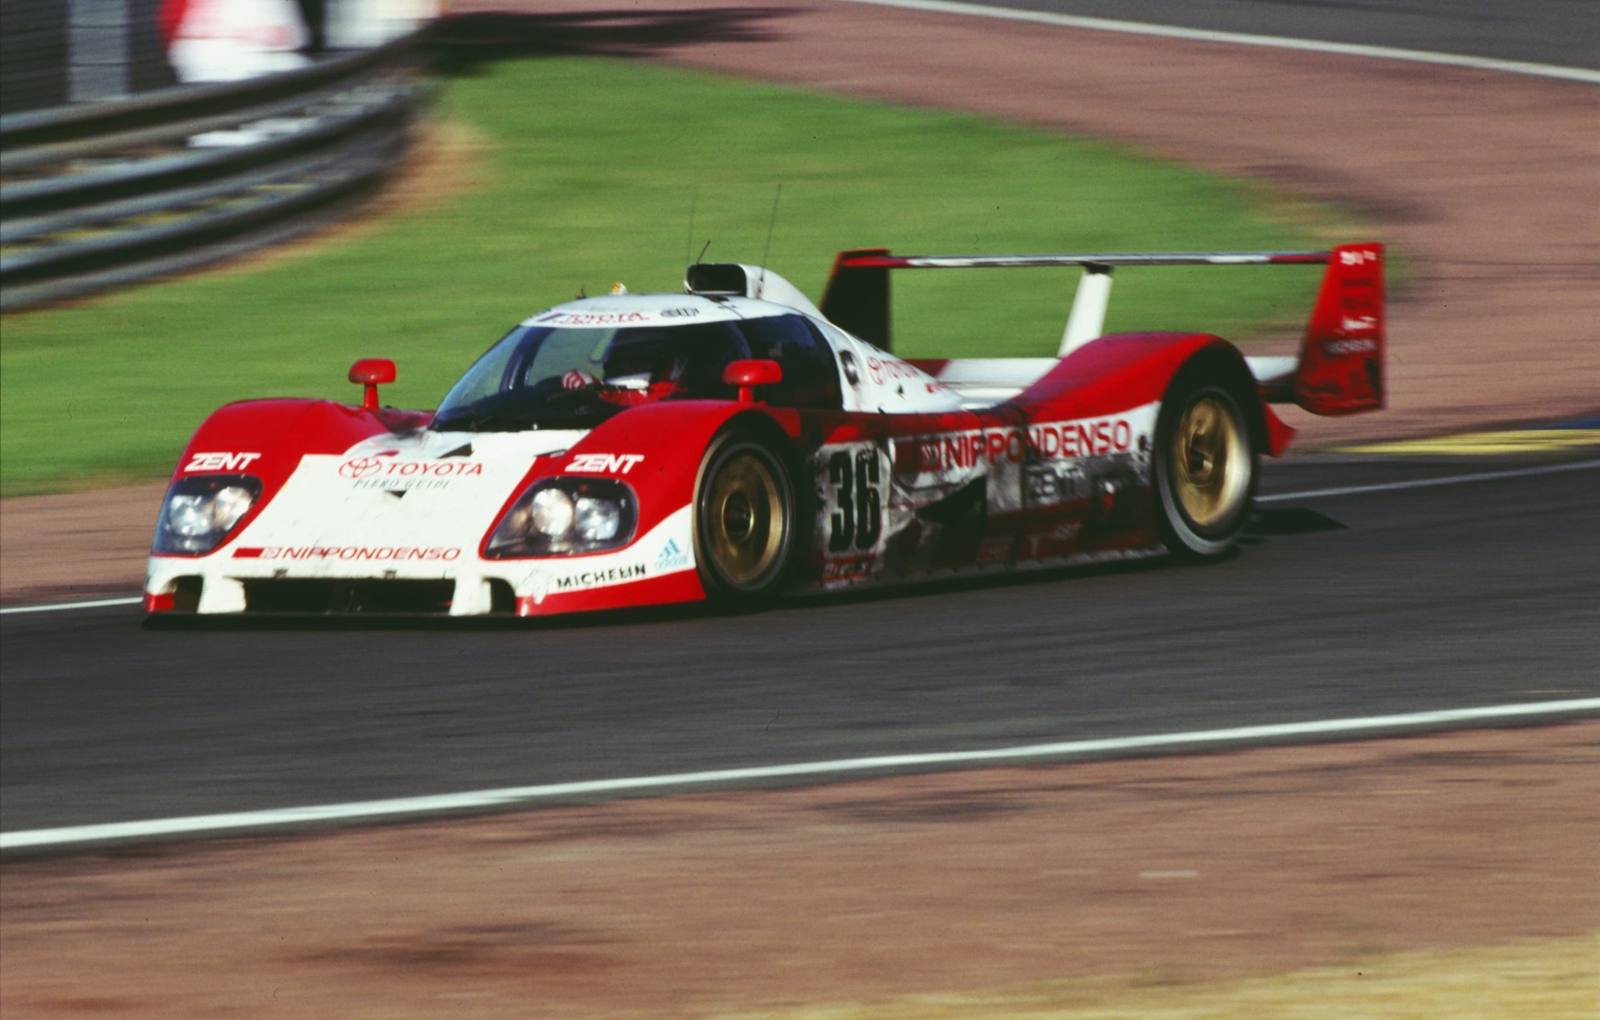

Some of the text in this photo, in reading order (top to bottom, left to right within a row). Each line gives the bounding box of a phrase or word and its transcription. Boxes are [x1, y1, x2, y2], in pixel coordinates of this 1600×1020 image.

[943, 420, 1132, 468] NIPPONDENSO
[185, 452, 262, 471] ZENT
[388, 462, 484, 475] TOYOTA
[564, 453, 645, 474] ZENT
[829, 450, 880, 552] 36
[282, 547, 462, 561] NIPPONDENSO
[557, 563, 646, 588] MICHELIN
